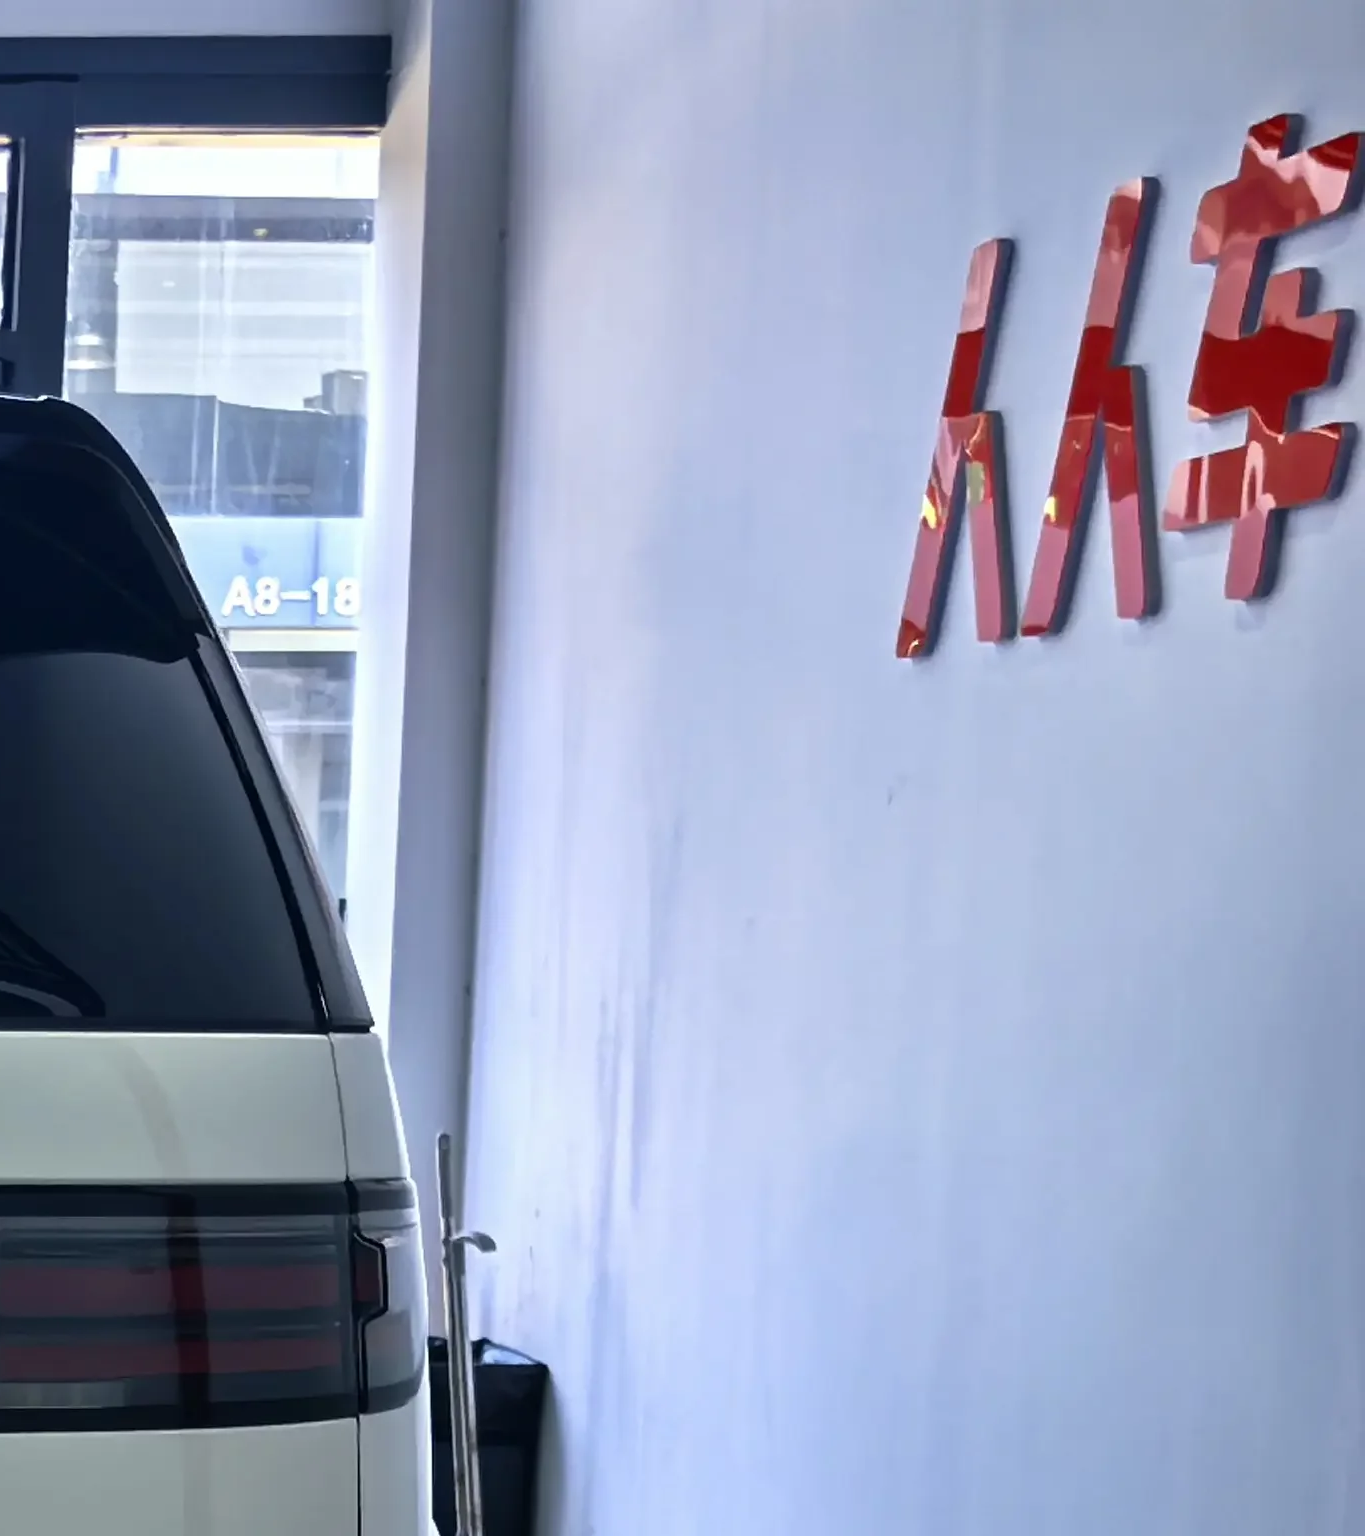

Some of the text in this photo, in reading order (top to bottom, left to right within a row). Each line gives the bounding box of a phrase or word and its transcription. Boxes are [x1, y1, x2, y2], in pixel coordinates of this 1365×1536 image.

[896, 113, 1365, 658] 人人车
[221, 575, 361, 617] A8-18
